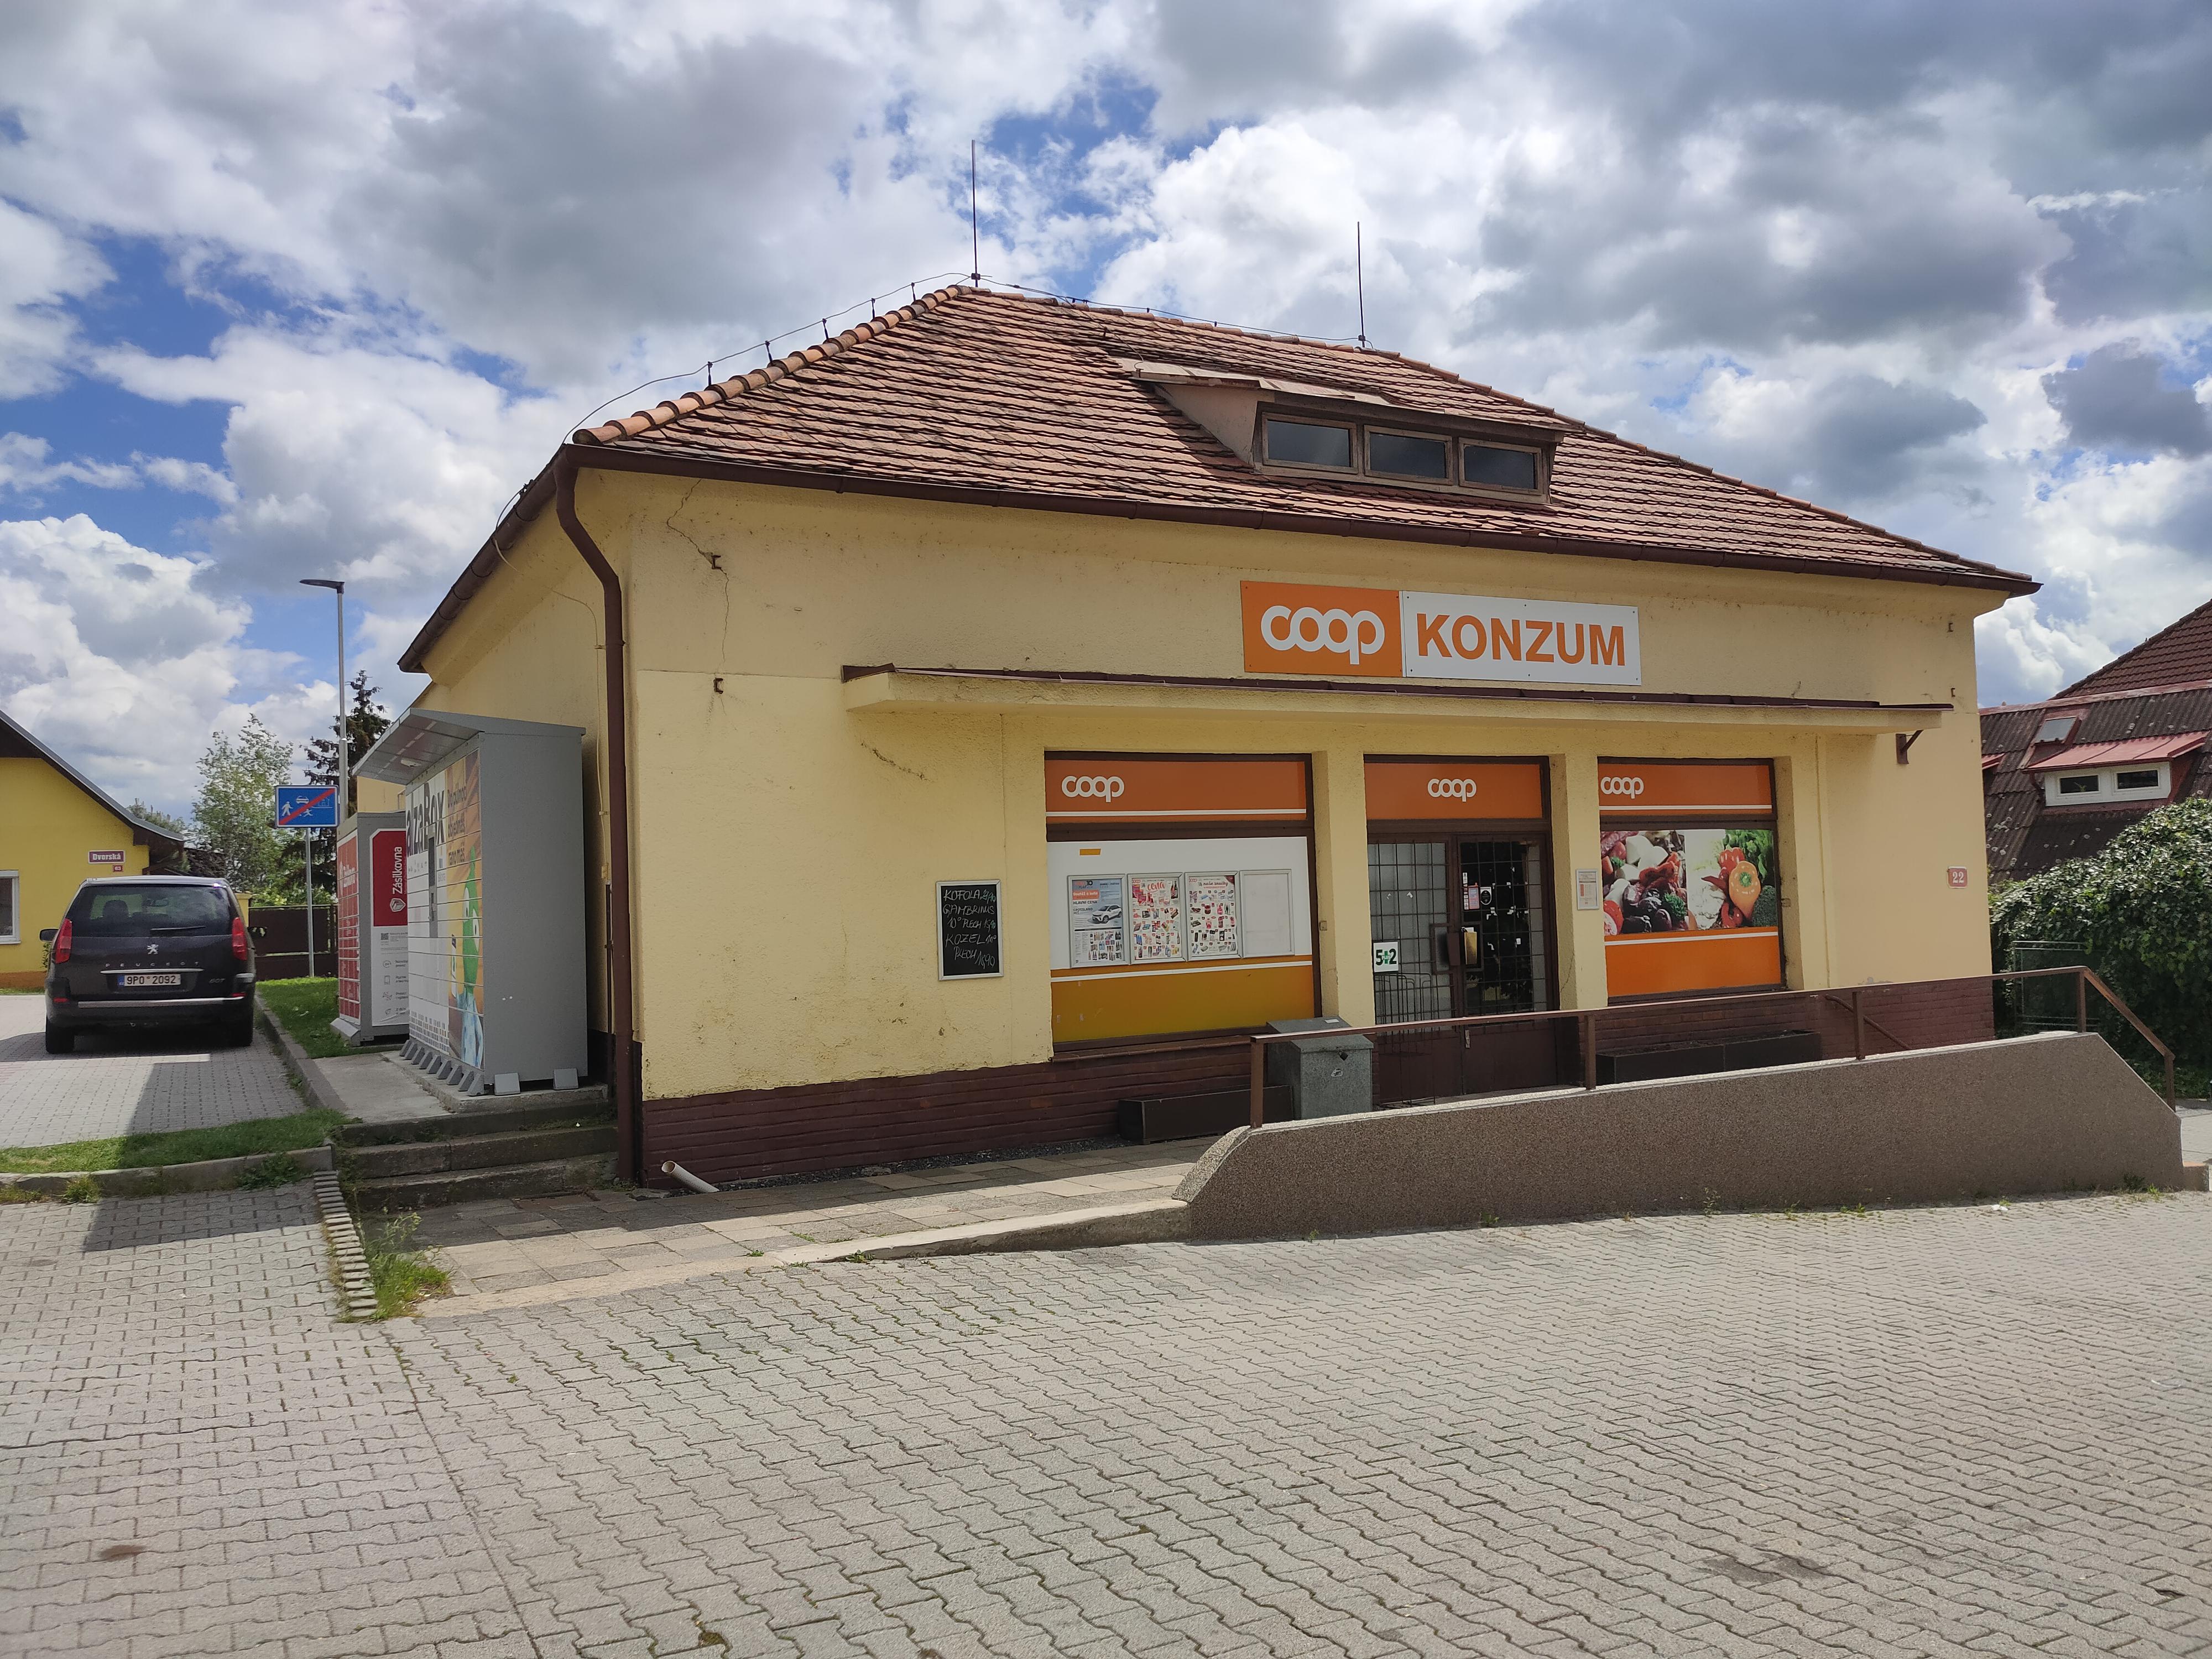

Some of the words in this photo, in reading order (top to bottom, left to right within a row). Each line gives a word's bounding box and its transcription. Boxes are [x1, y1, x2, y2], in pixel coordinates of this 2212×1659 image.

[1416, 613, 1626, 666] KONZUM
[392, 846, 403, 894] Zásilkovna
[1953, 871, 1964, 883] 22
[943, 889, 980, 901] KOFOLA
[943, 904, 995, 918] GAMBRINUS
[962, 918, 982, 929] PLECH
[945, 933, 985, 948] KOZEL
[954, 946, 978, 961] PLECH
[152, 975, 176, 984] 2092
